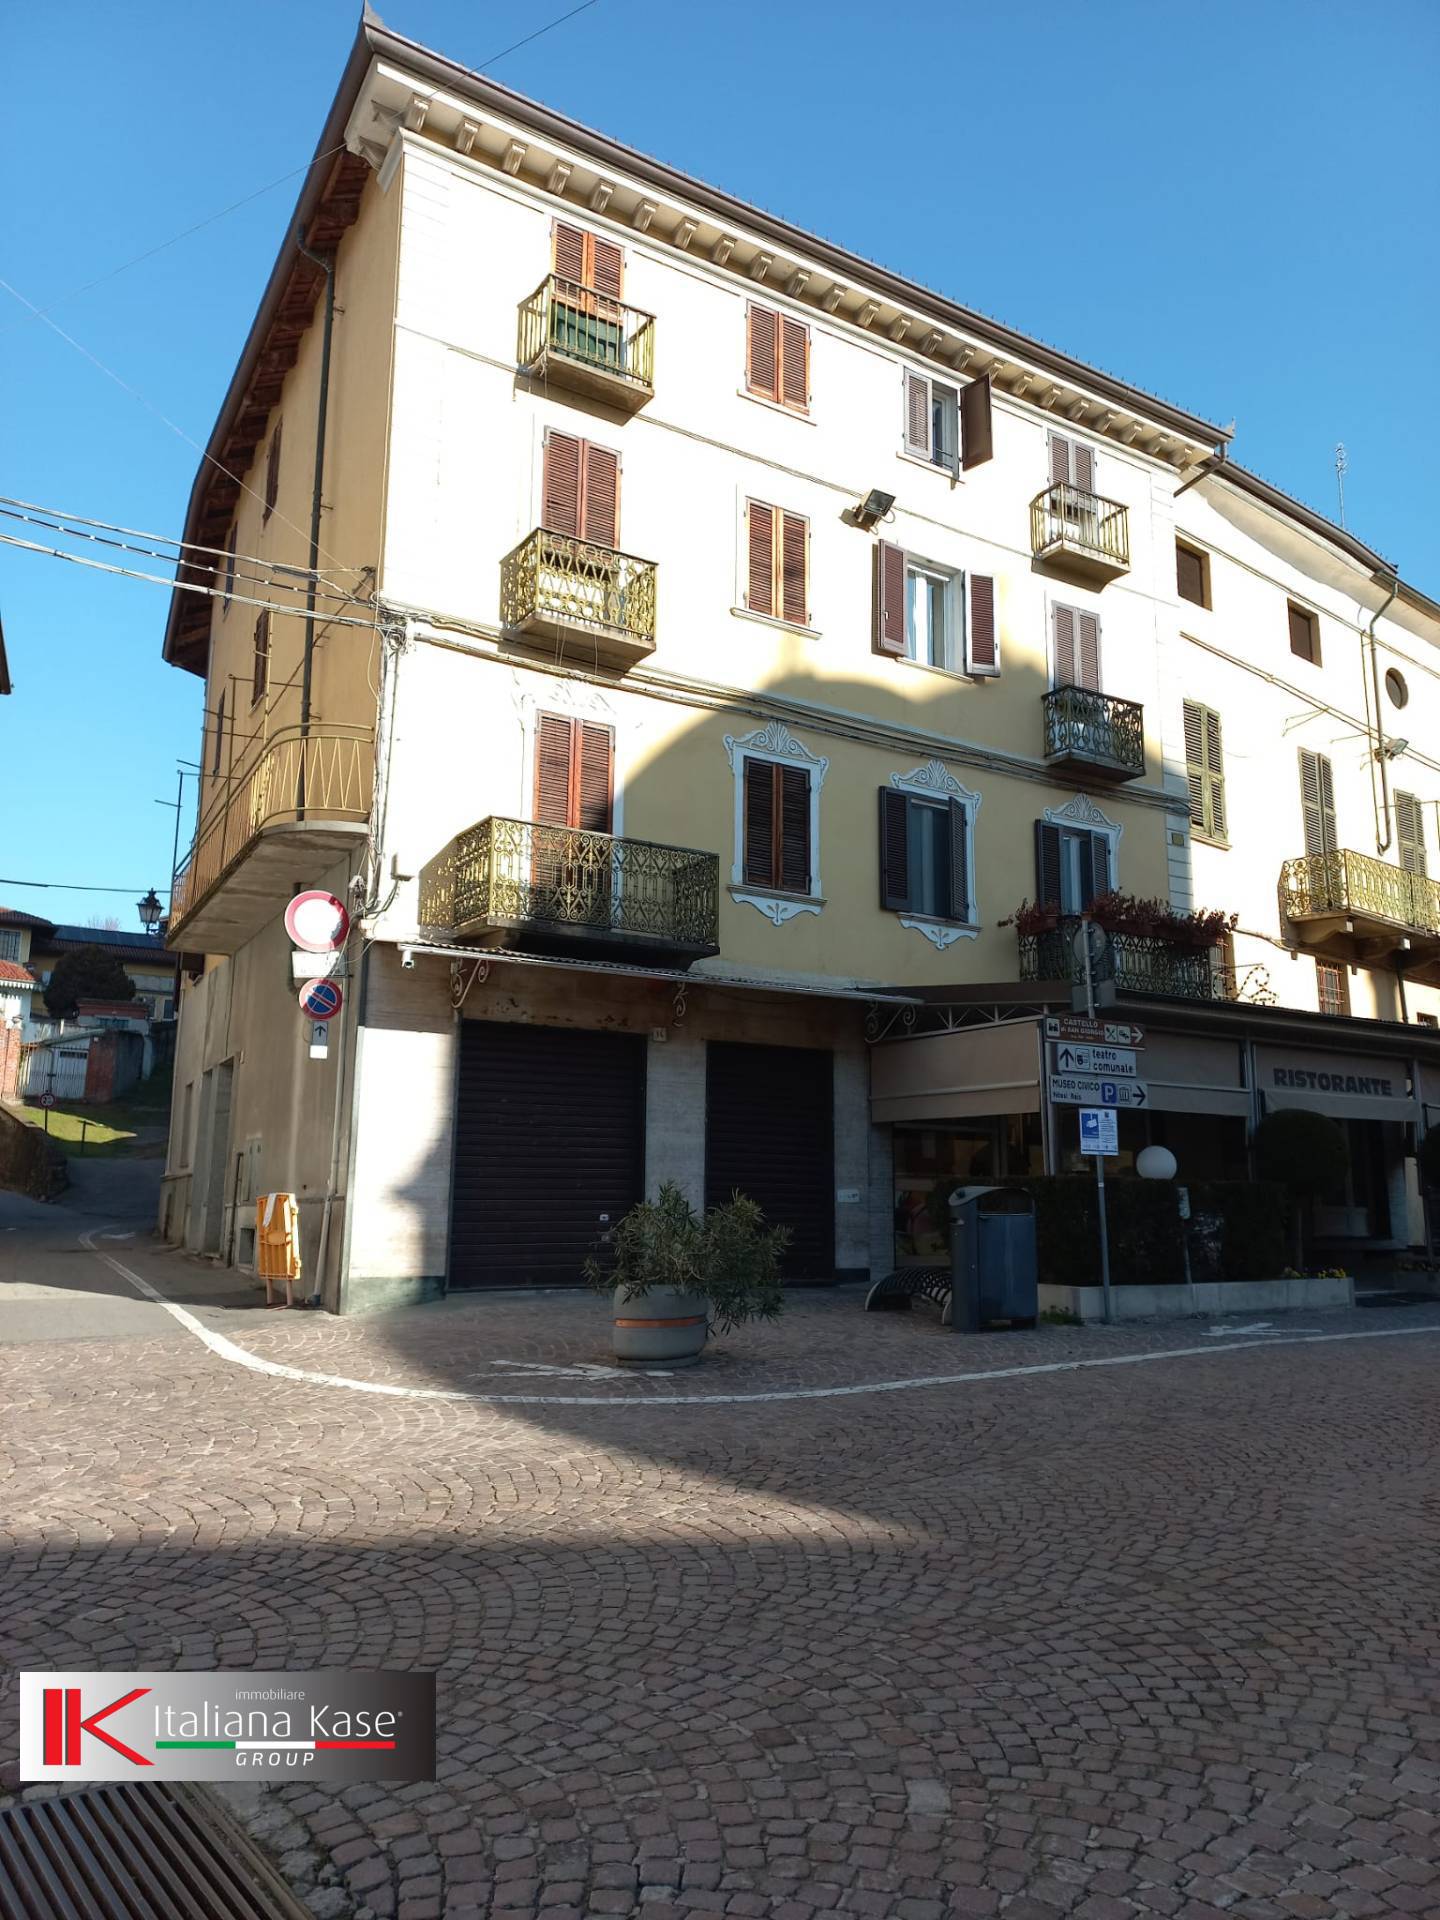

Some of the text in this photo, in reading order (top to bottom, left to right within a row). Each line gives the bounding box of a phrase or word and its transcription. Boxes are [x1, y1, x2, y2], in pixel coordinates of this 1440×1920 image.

[1063, 1018, 1098, 1028] CASTELLO
[1092, 1048, 1117, 1060] teatro
[1093, 1063, 1134, 1074] comunale
[1052, 1078, 1076, 1089] MUSEO
[1077, 1080, 1100, 1092] CIVICO
[1273, 1068, 1392, 1097] RISTORANTE
